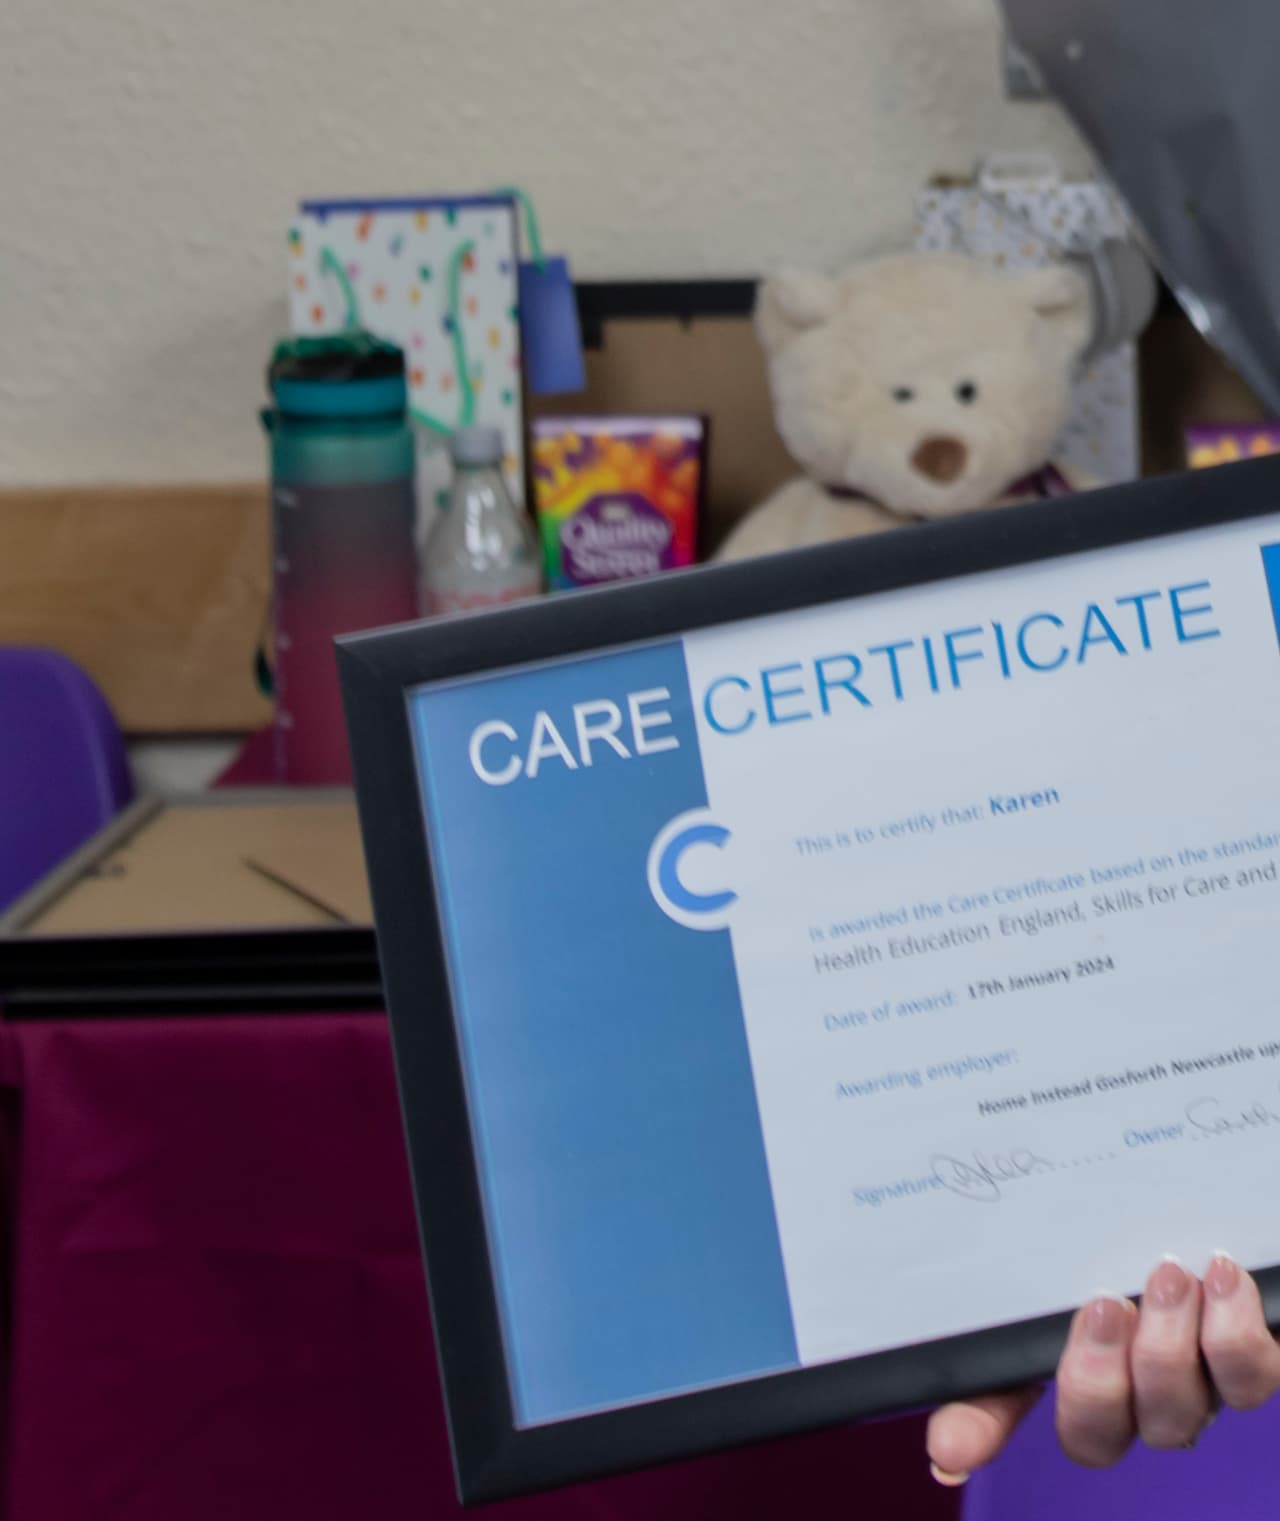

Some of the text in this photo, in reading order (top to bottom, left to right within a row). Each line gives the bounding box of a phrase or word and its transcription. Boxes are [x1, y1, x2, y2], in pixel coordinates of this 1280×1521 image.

[469, 579, 1221, 786] CARE CERTIFICATE
[795, 836, 832, 857] This
[836, 829, 851, 848] is
[855, 826, 875, 844] to
[879, 811, 936, 841] certify
[988, 786, 1060, 817] Karen
[813, 942, 883, 975] Health
[887, 921, 992, 960] Education
[998, 900, 1087, 937] England,
[1091, 886, 1145, 918] Skills
[1147, 881, 1179, 906] for
[1183, 873, 1231, 898] Care
[1235, 859, 1278, 888] and
[828, 905, 909, 940] awarded
[912, 900, 943, 921] the
[947, 891, 990, 914] Care
[993, 871, 1086, 905] Certificate
[1089, 856, 1146, 884] based
[1150, 853, 1175, 873] on
[1177, 846, 1209, 867] the
[824, 1010, 868, 1033] Date
[871, 1000, 893, 1023] of
[967, 978, 1004, 1001] 17th
[1008, 964, 1072, 994] January
[1075, 954, 1116, 980] 2024
[836, 1068, 924, 1101] Awarding
[977, 1094, 1029, 1118] Home
[1031, 1076, 1094, 1107] Instead
[1095, 1063, 1168, 1094] Gosforth
[1170, 1044, 1256, 1077] Newcastle
[1123, 1124, 1185, 1150] Owner
